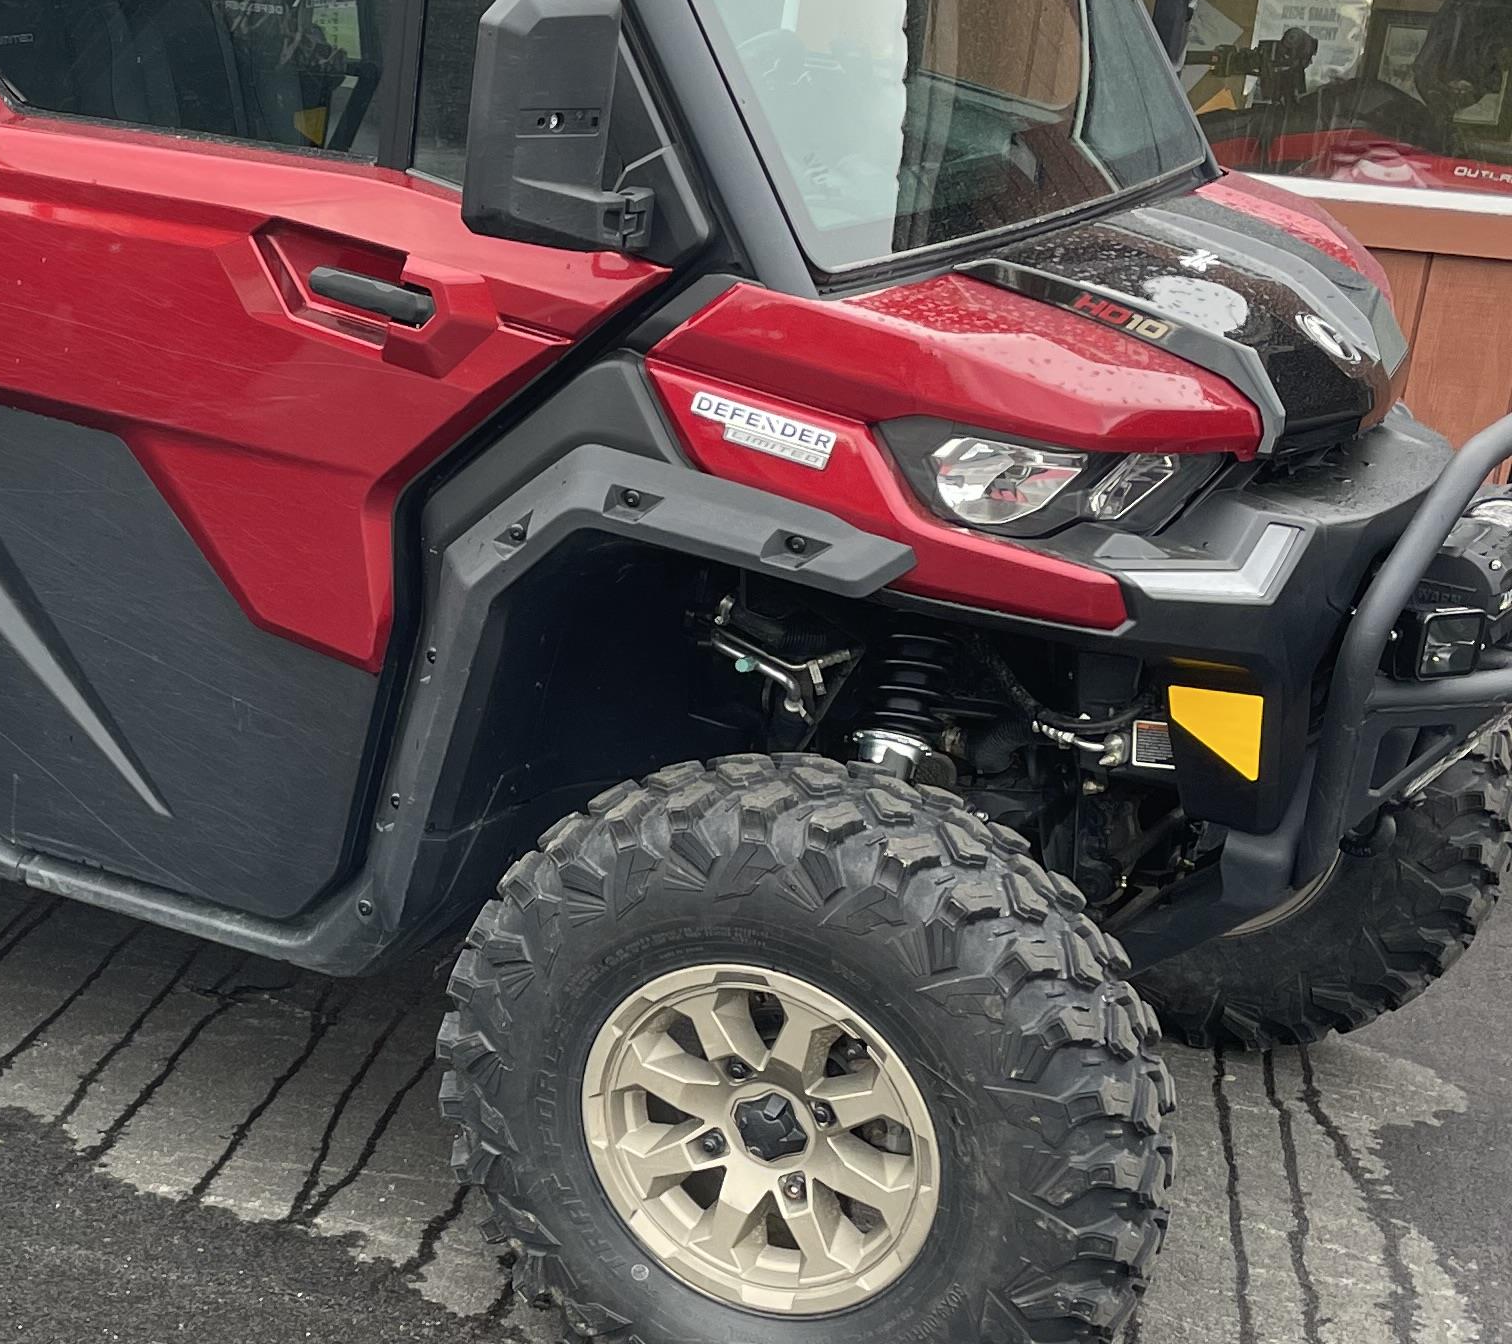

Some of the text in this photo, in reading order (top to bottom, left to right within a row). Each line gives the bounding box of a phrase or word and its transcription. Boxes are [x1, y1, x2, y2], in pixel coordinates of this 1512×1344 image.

[1073, 291, 1170, 340] HD10
[696, 396, 832, 449] DEFENDER
[731, 430, 820, 464] LIMITED
